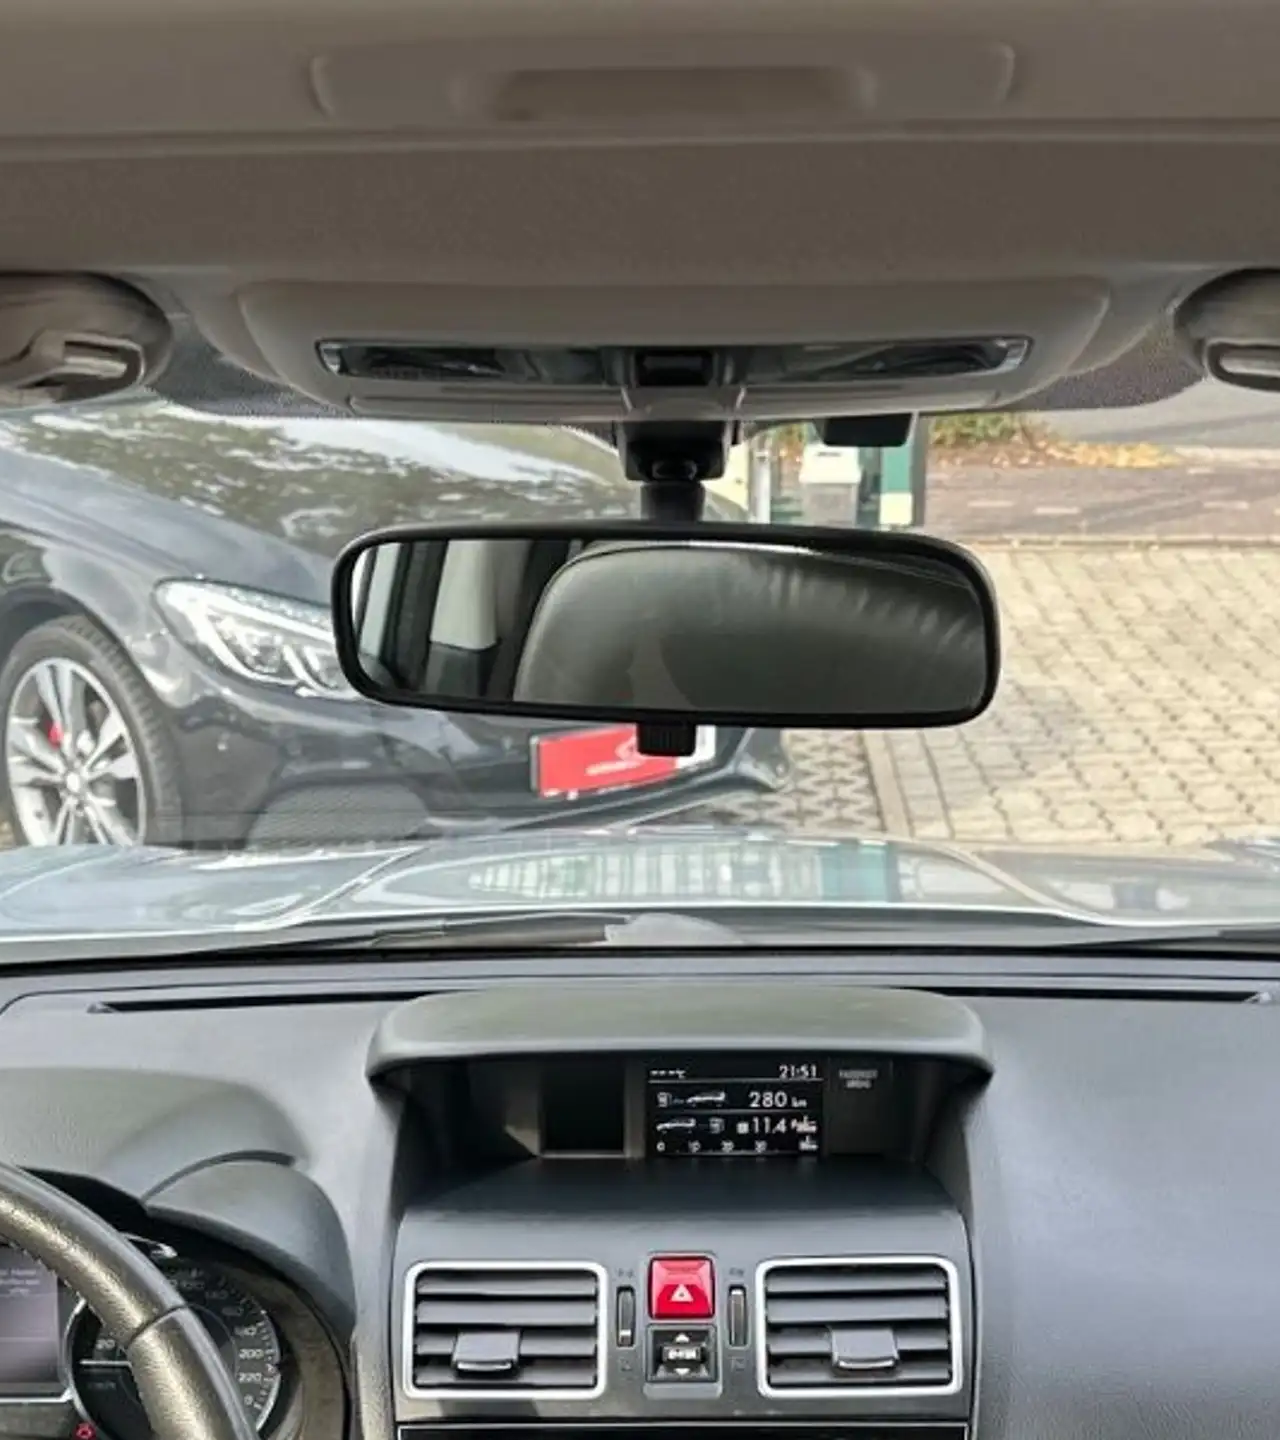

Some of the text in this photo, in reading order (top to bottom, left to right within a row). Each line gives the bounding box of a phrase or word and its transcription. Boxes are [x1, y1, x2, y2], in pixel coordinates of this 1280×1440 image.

[779, 1064, 816, 1079] 21:51
[749, 1091, 787, 1107] 280
[753, 1117, 786, 1133] 11.4
[239, 1348, 263, 1360] 200
[238, 1372, 262, 1383] 220
